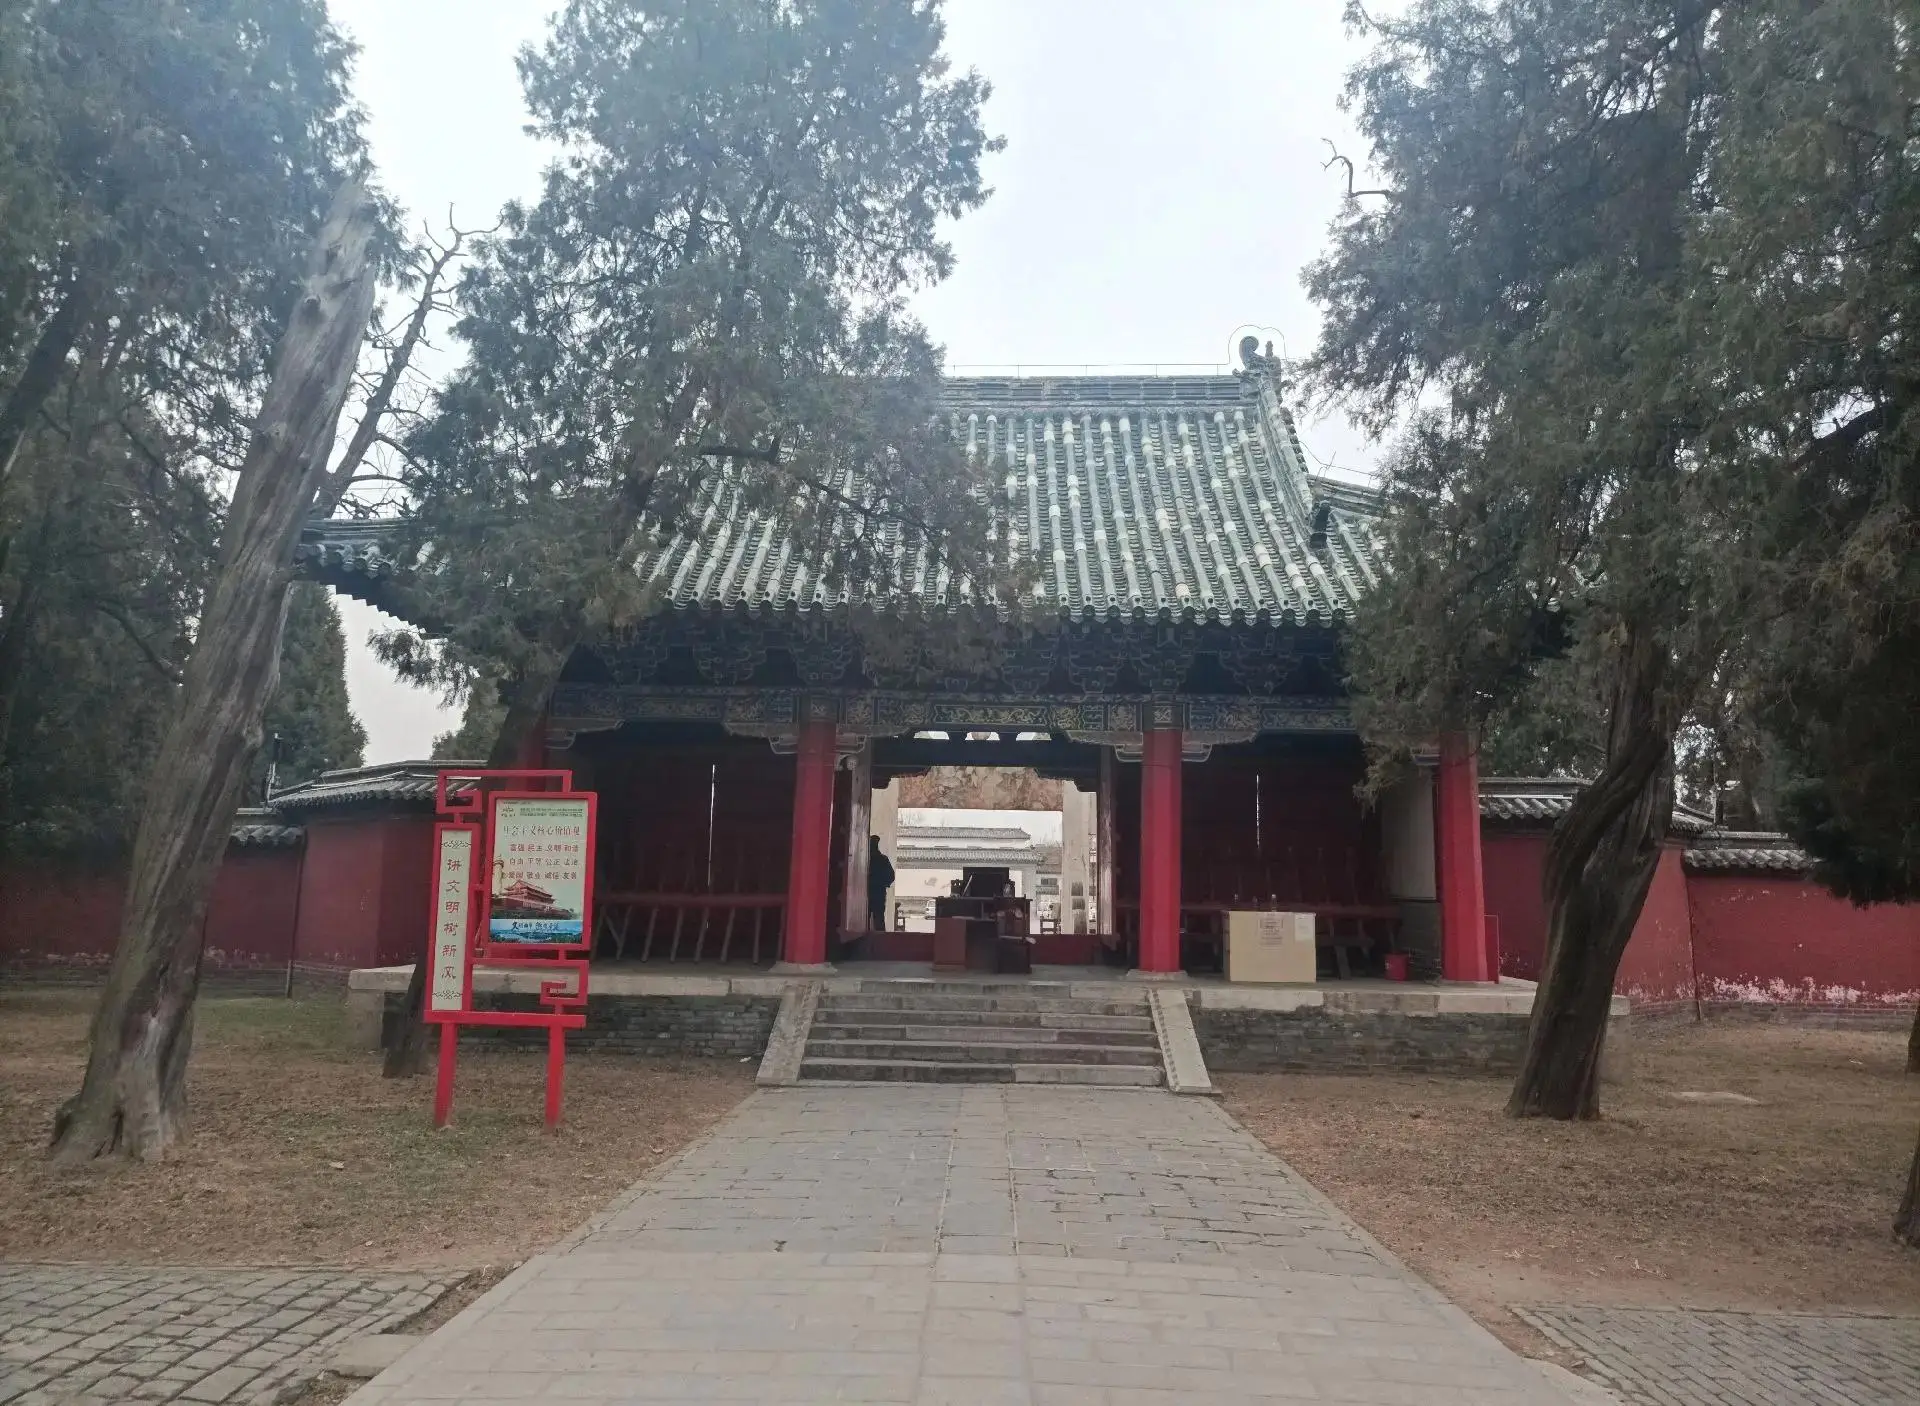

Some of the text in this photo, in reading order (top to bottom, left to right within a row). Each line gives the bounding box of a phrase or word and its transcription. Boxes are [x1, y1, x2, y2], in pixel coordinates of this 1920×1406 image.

[441, 858, 462, 980] 讲文明树新风
